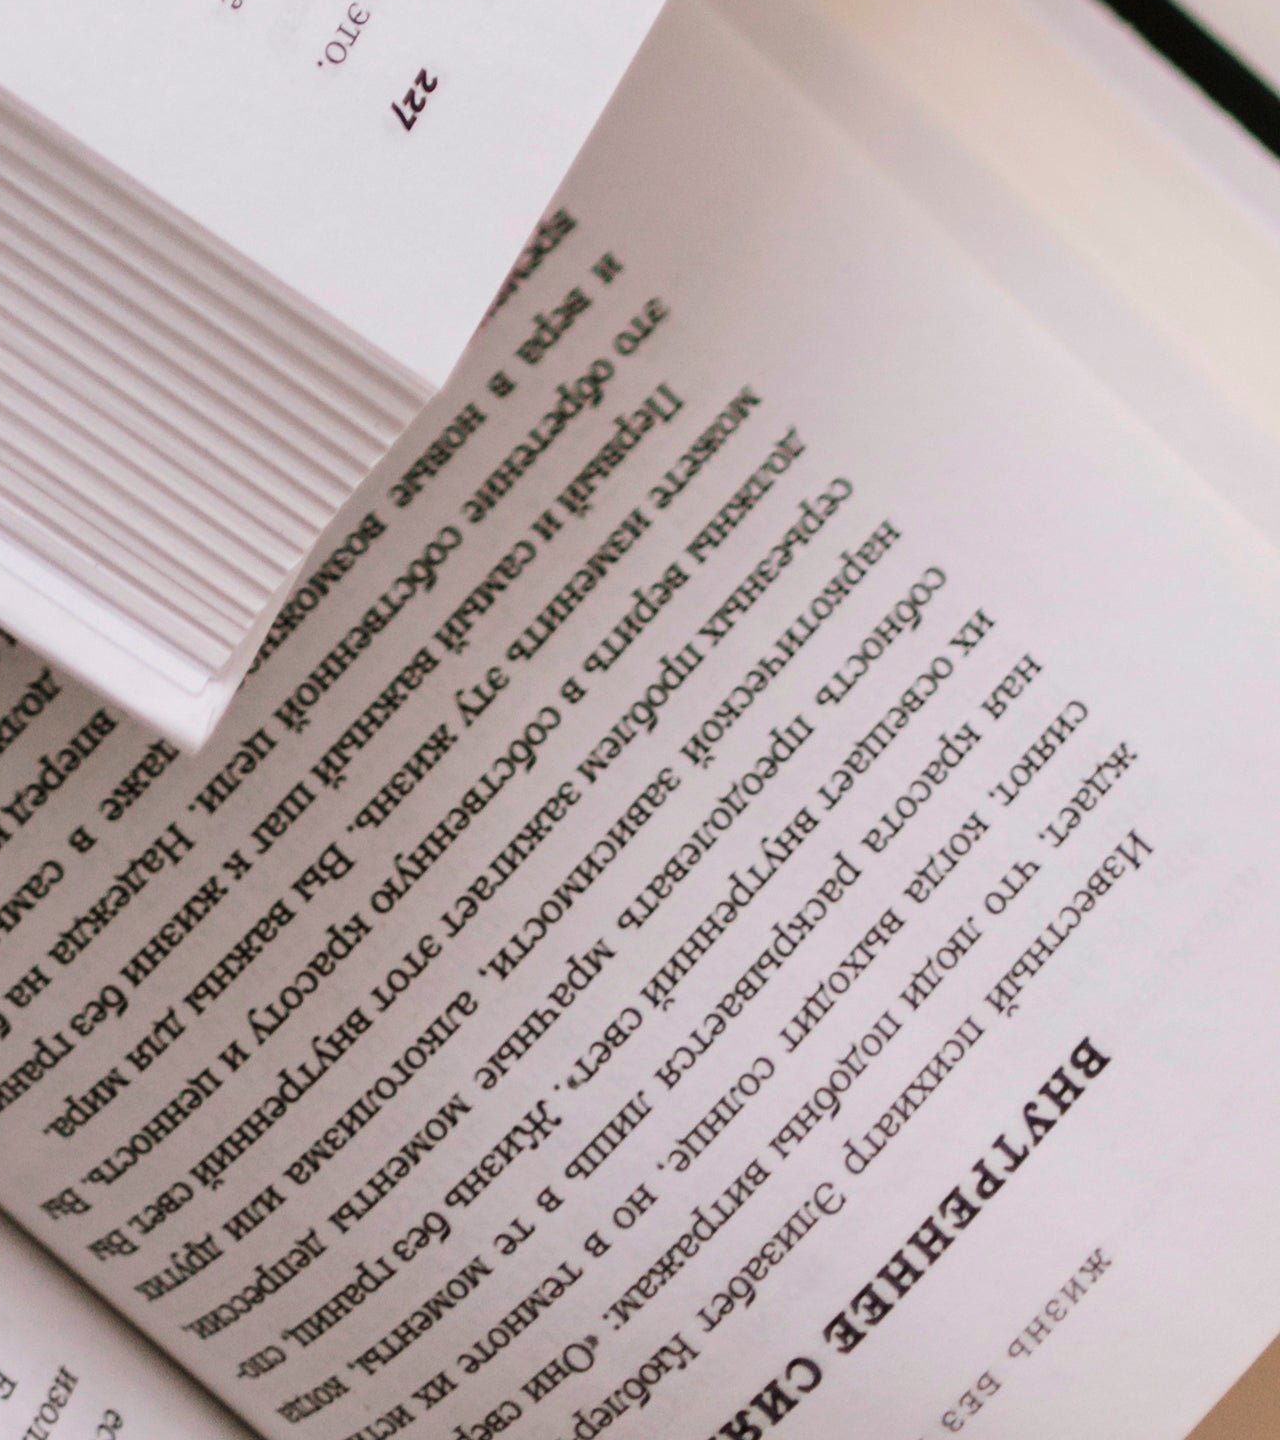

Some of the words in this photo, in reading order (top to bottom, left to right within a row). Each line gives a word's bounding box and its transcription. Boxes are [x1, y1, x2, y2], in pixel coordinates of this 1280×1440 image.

[315, 0, 373, 69] это.
[389, 66, 439, 134] 227
[461, 357, 616, 525] обретение
[271, 524, 465, 736] собственной
[678, 518, 904, 771] наркотической
[858, 720, 984, 855] красота
[476, 766, 683, 983] зависимости,
[982, 826, 1156, 1020] Известный
[652, 848, 864, 1092] раскрывается
[562, 1088, 655, 1181] лишь
[840, 1014, 987, 1177] психиатр
[694, 1180, 849, 1335] Элизабет
[821, 1034, 1113, 1356] ВНУТРЕННЕЕ
[1006, 1246, 1114, 1360] ЖИЗНЬ
[708, 1357, 822, 1439] СИЯ
[939, 1369, 1003, 1434] БЕЗ
